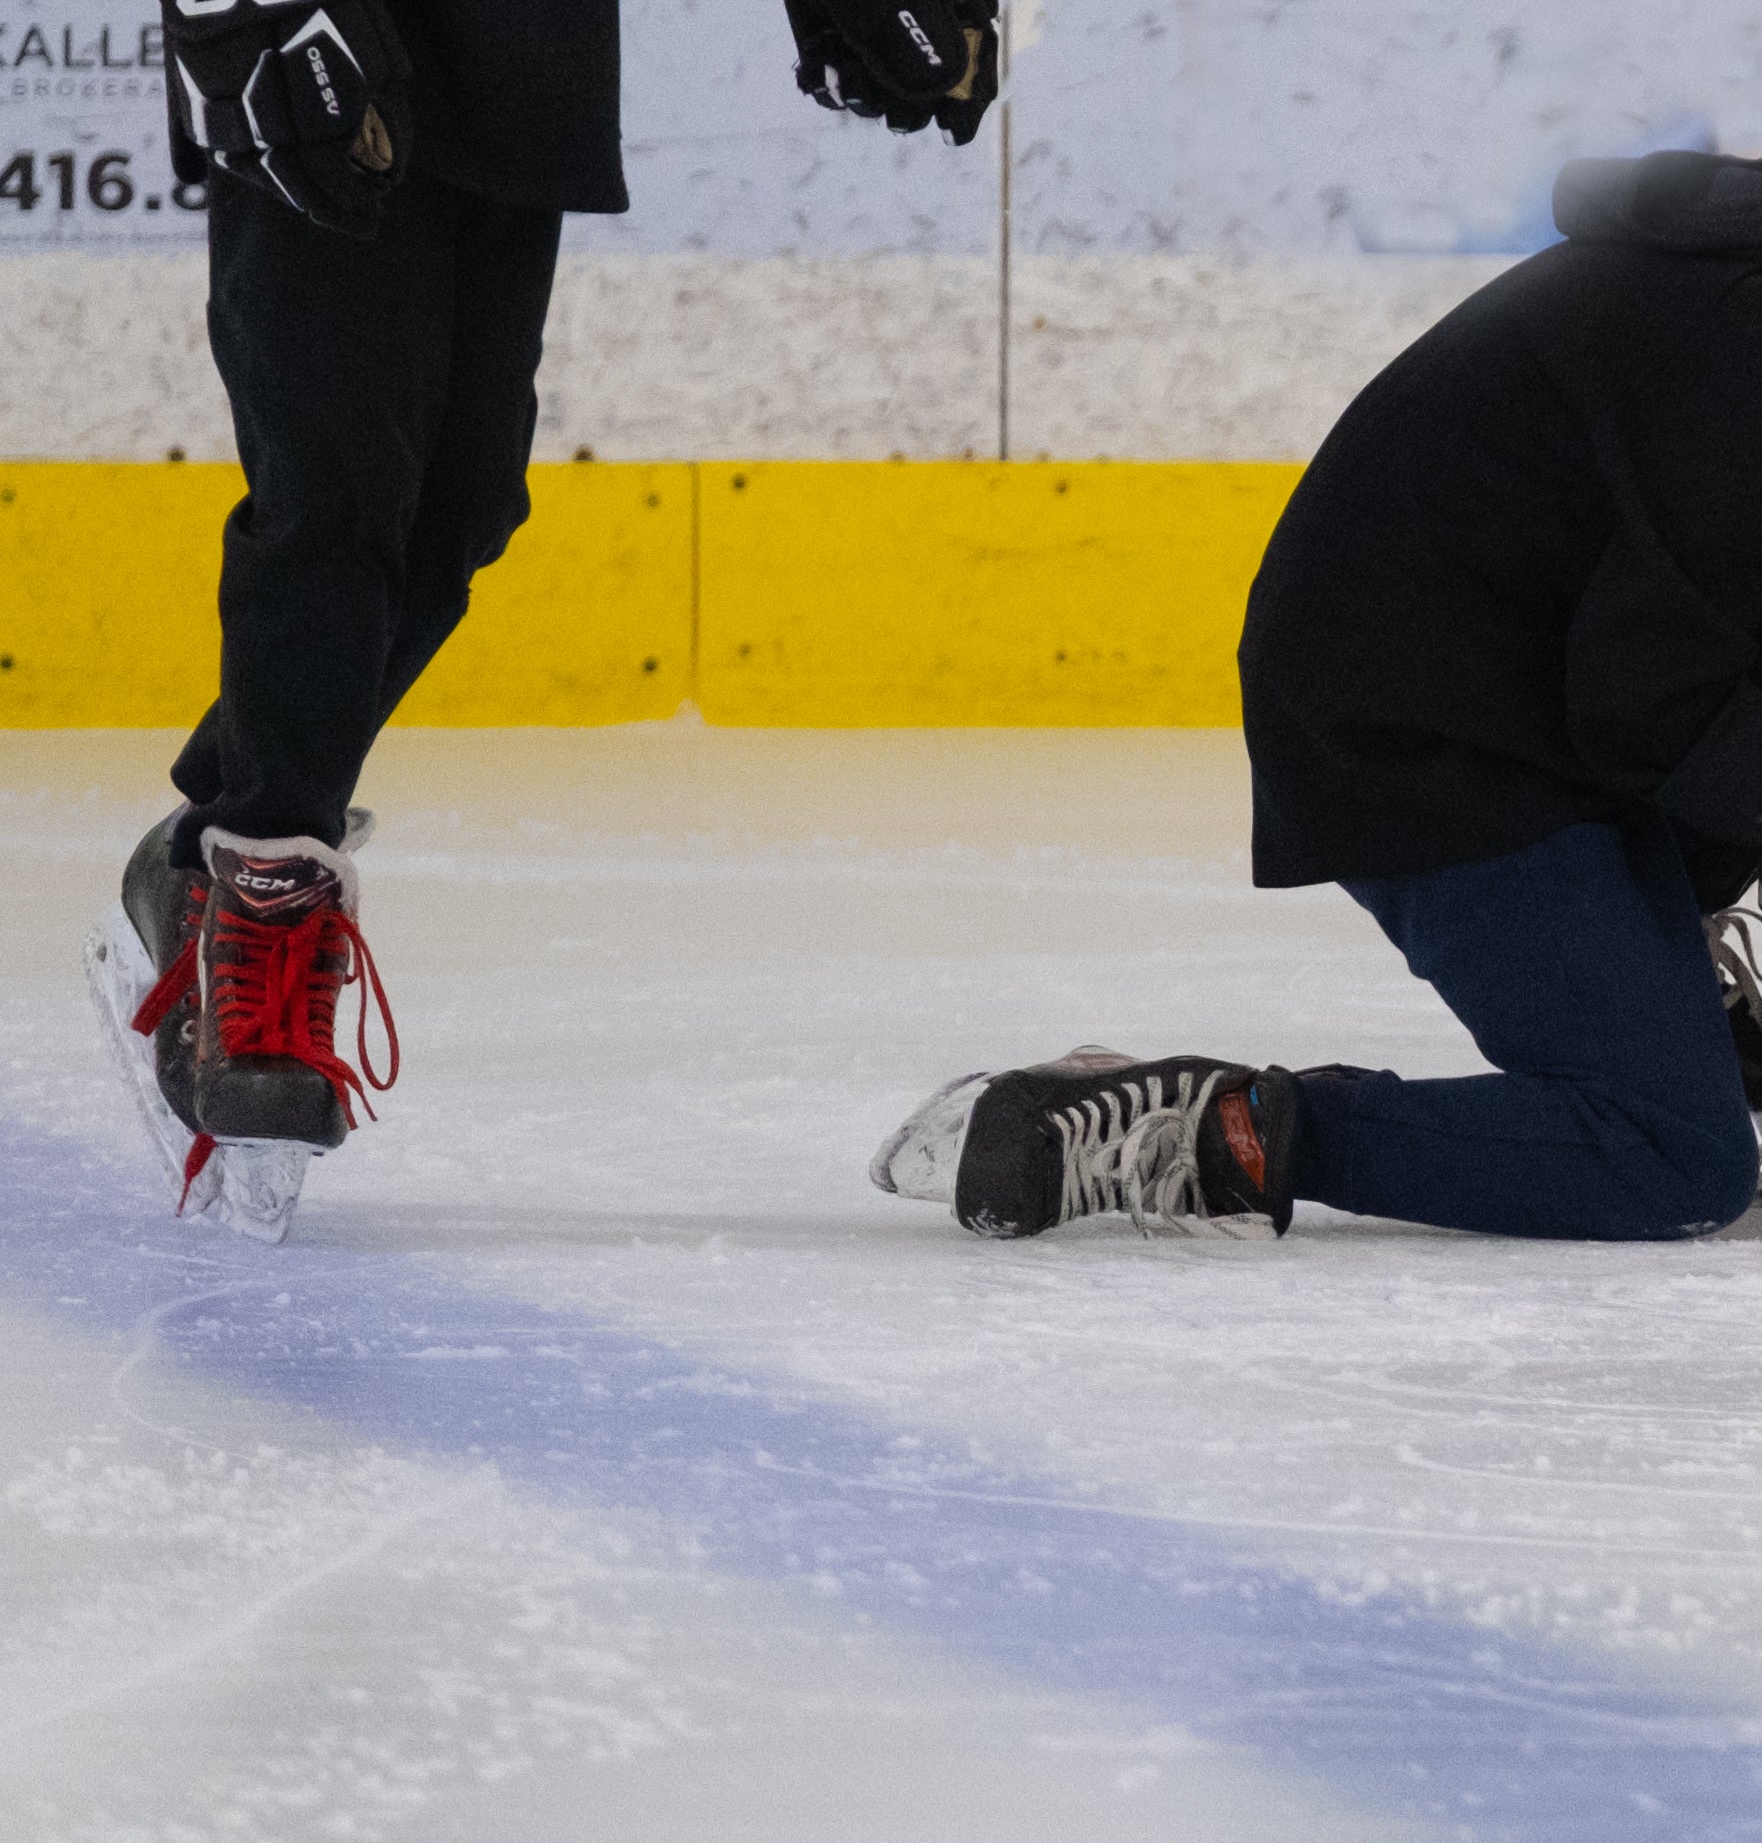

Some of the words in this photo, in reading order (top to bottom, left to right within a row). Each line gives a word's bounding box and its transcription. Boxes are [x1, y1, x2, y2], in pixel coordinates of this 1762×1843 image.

[0, 23, 164, 68] ALLE
[898, 10, 943, 66] CCM
[235, 872, 296, 891] CCM
